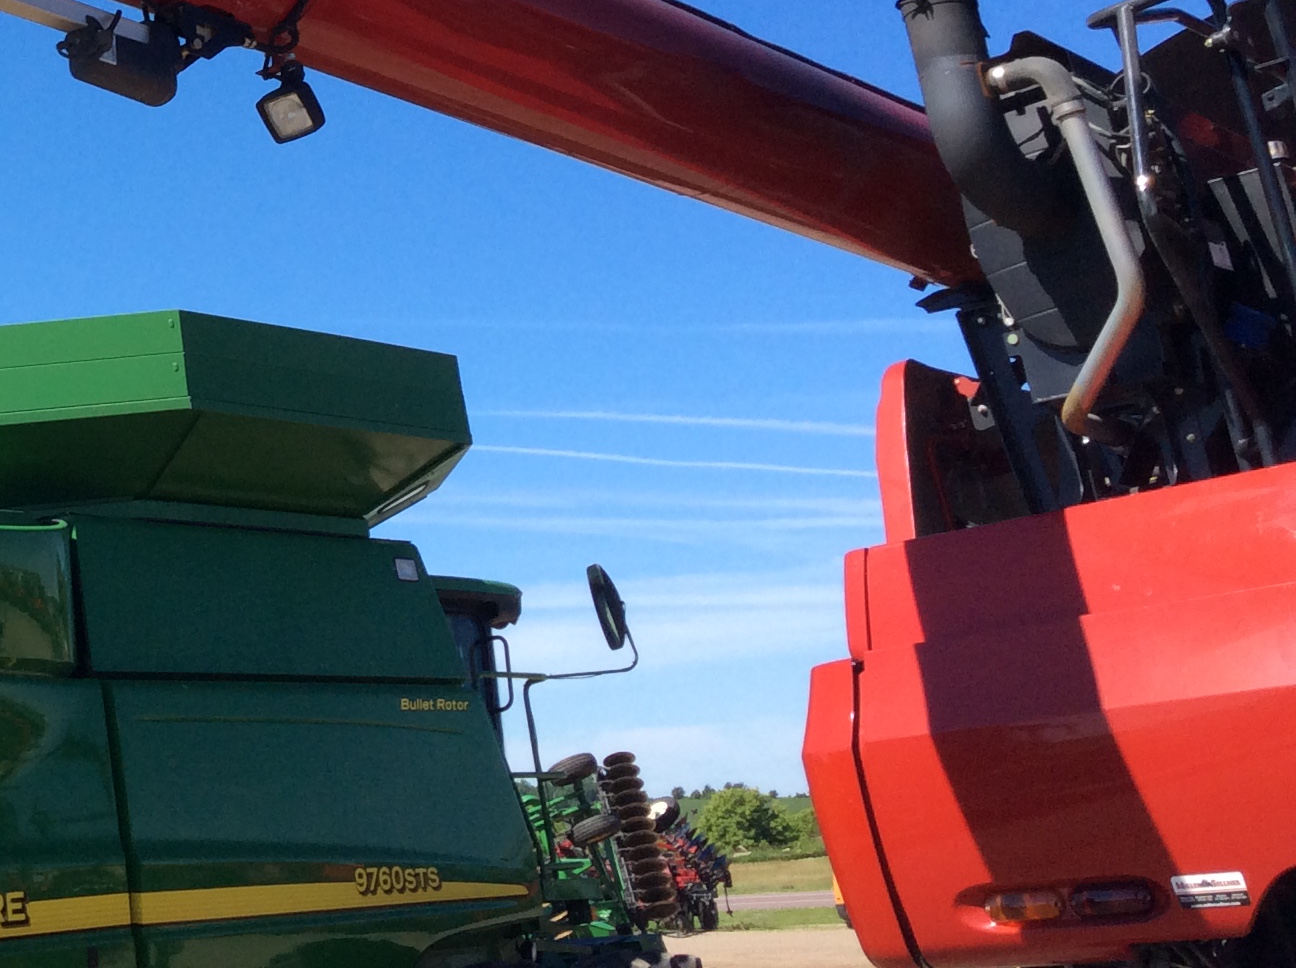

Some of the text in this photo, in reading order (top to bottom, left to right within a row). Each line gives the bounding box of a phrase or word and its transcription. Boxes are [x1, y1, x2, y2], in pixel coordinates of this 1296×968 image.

[400, 697, 469, 711] Bullet Rotor
[354, 865, 442, 895] 9760STS
